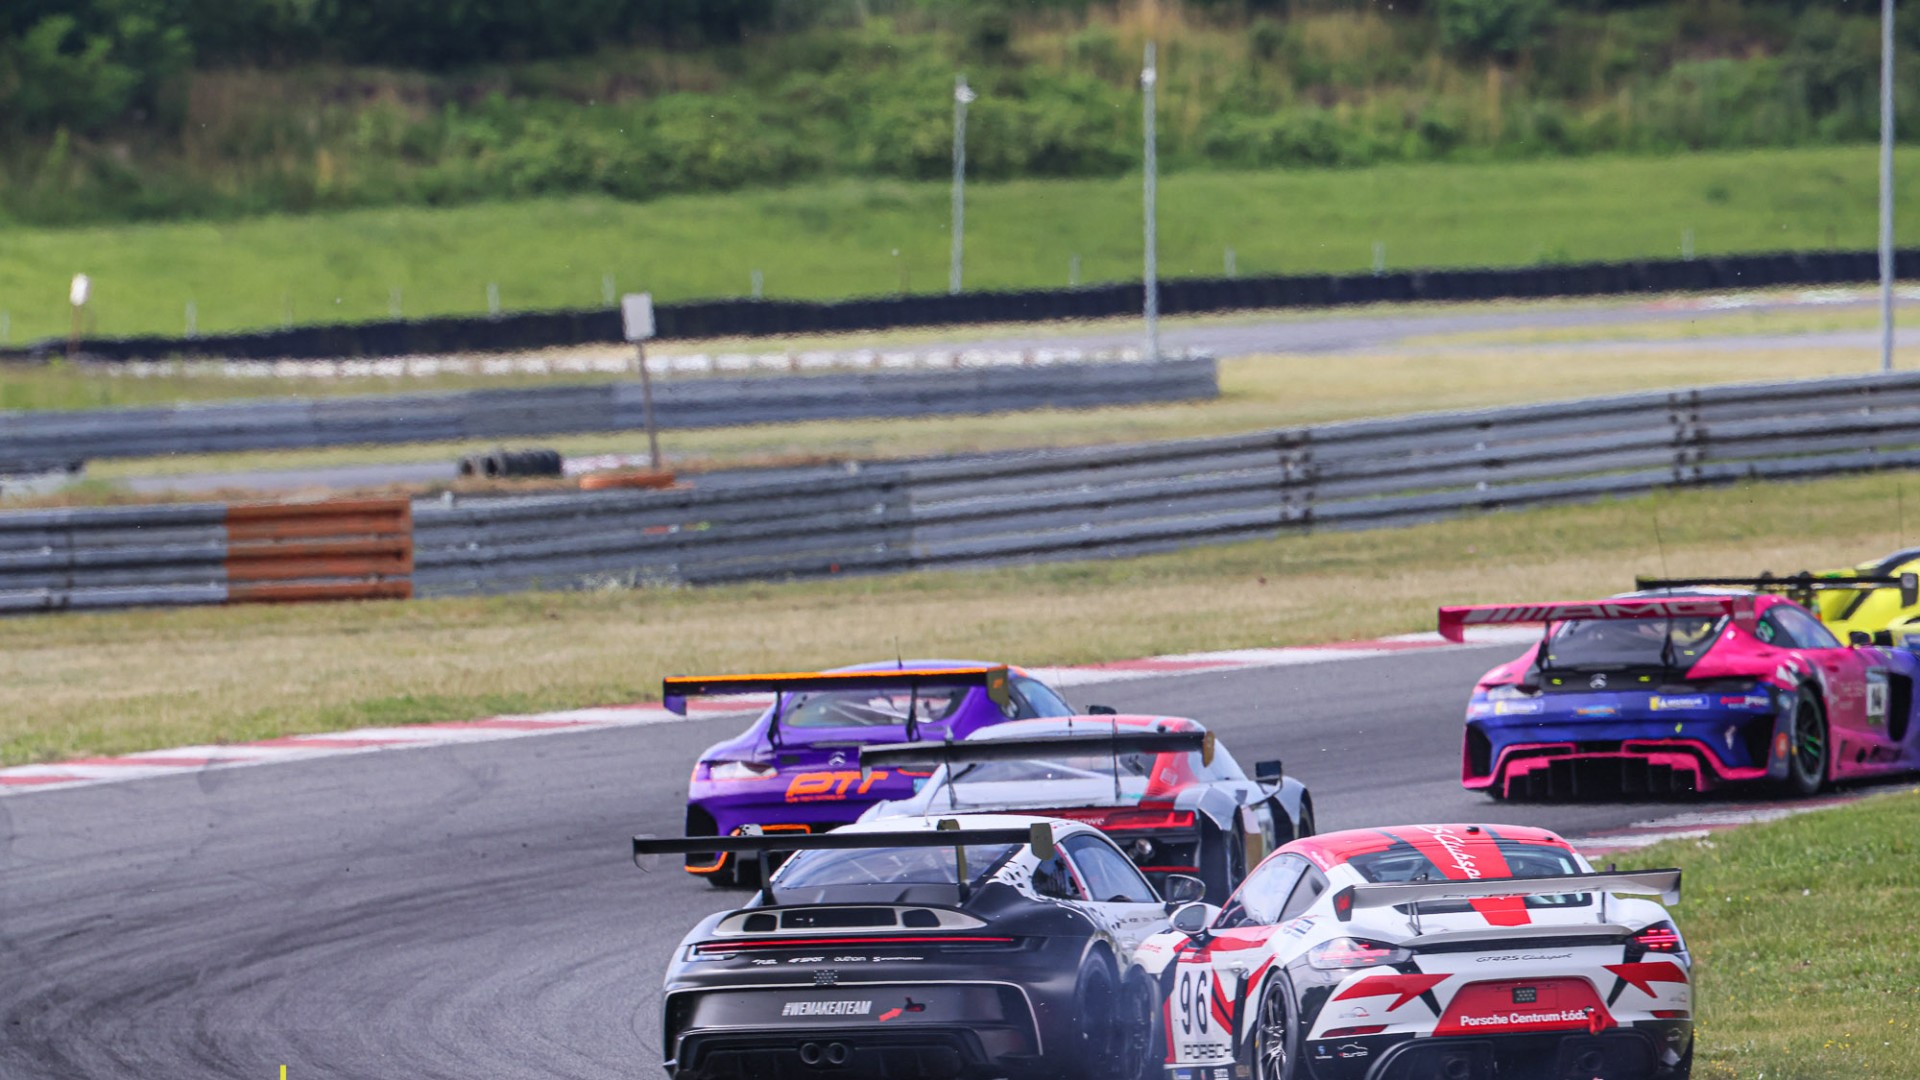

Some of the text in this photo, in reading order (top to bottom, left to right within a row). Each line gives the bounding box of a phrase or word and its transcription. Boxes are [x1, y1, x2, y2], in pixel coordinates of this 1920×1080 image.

[1549, 600, 1727, 620] AMG
[1433, 834, 1481, 879] Clubsp
[782, 1001, 872, 1016] #WEMAKEATEAM
[1180, 970, 1207, 1035] 96
[1460, 1015, 1509, 1026] Porsche
[1510, 1011, 1560, 1023] Centrum
[1184, 1043, 1232, 1060] PORSCH
